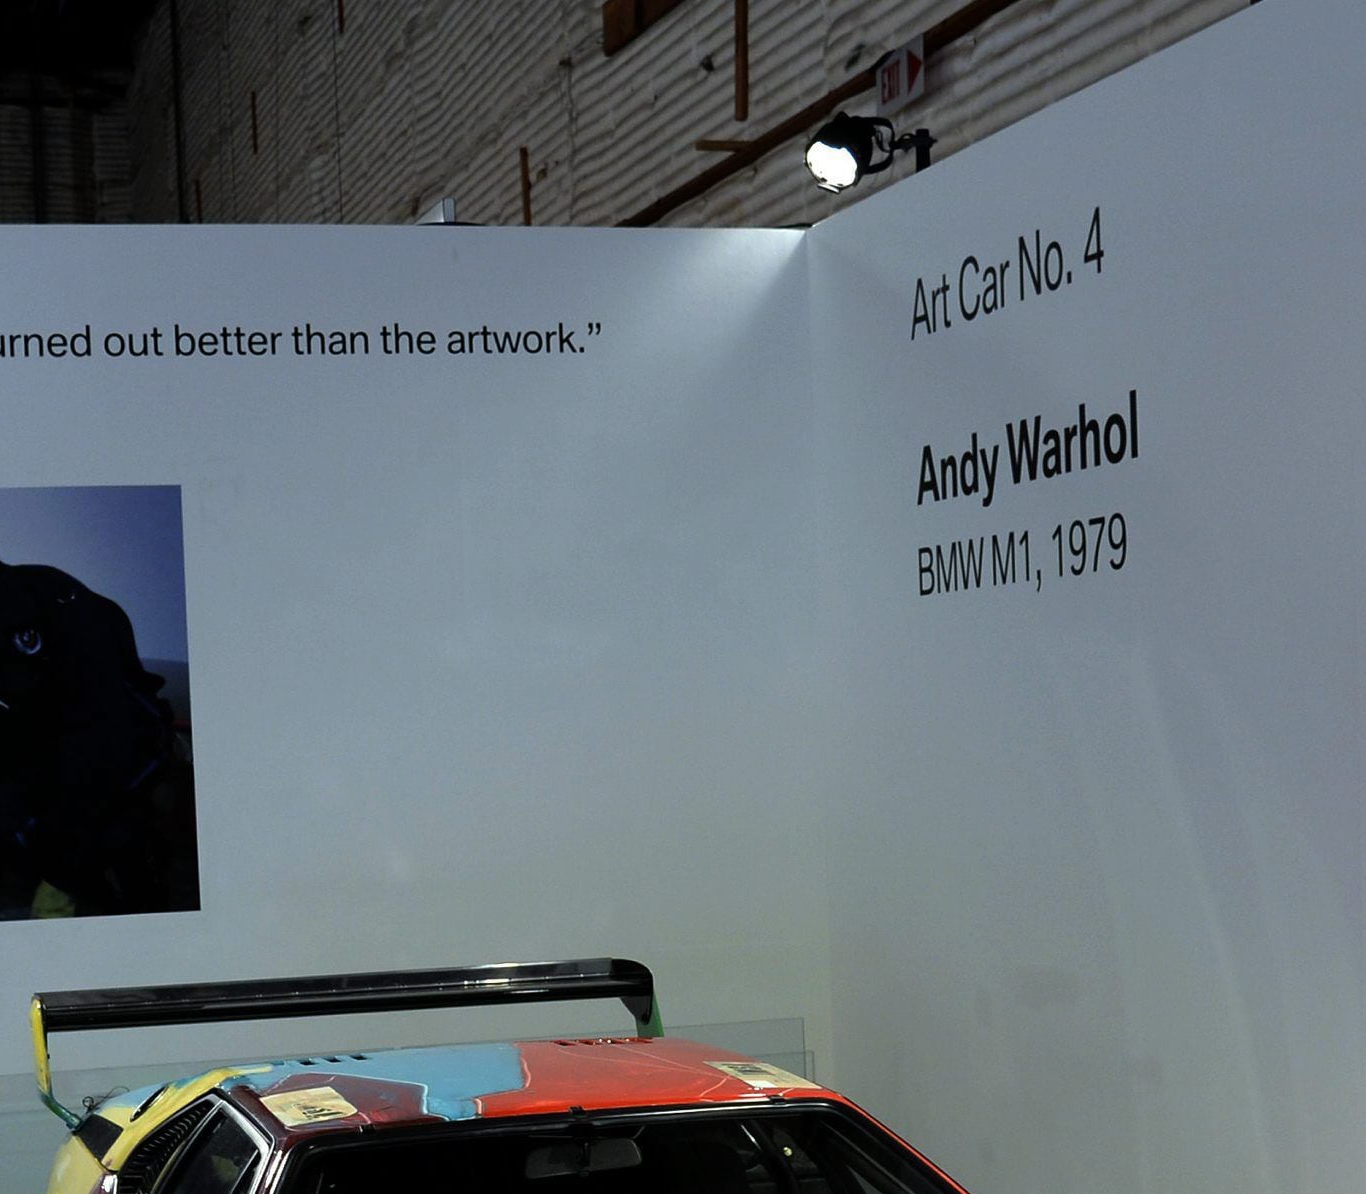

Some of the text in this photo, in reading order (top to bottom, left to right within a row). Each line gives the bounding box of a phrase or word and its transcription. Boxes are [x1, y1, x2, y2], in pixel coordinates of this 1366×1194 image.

[910, 206, 1105, 341] Art Car No. 4
[103, 327, 164, 357] out
[174, 323, 283, 357] better
[291, 323, 369, 356] than
[379, 322, 437, 355] the
[447, 322, 601, 355] artwork.”
[917, 389, 1139, 508] Andy Warhol
[918, 512, 1127, 597] BMW M1, 1979
